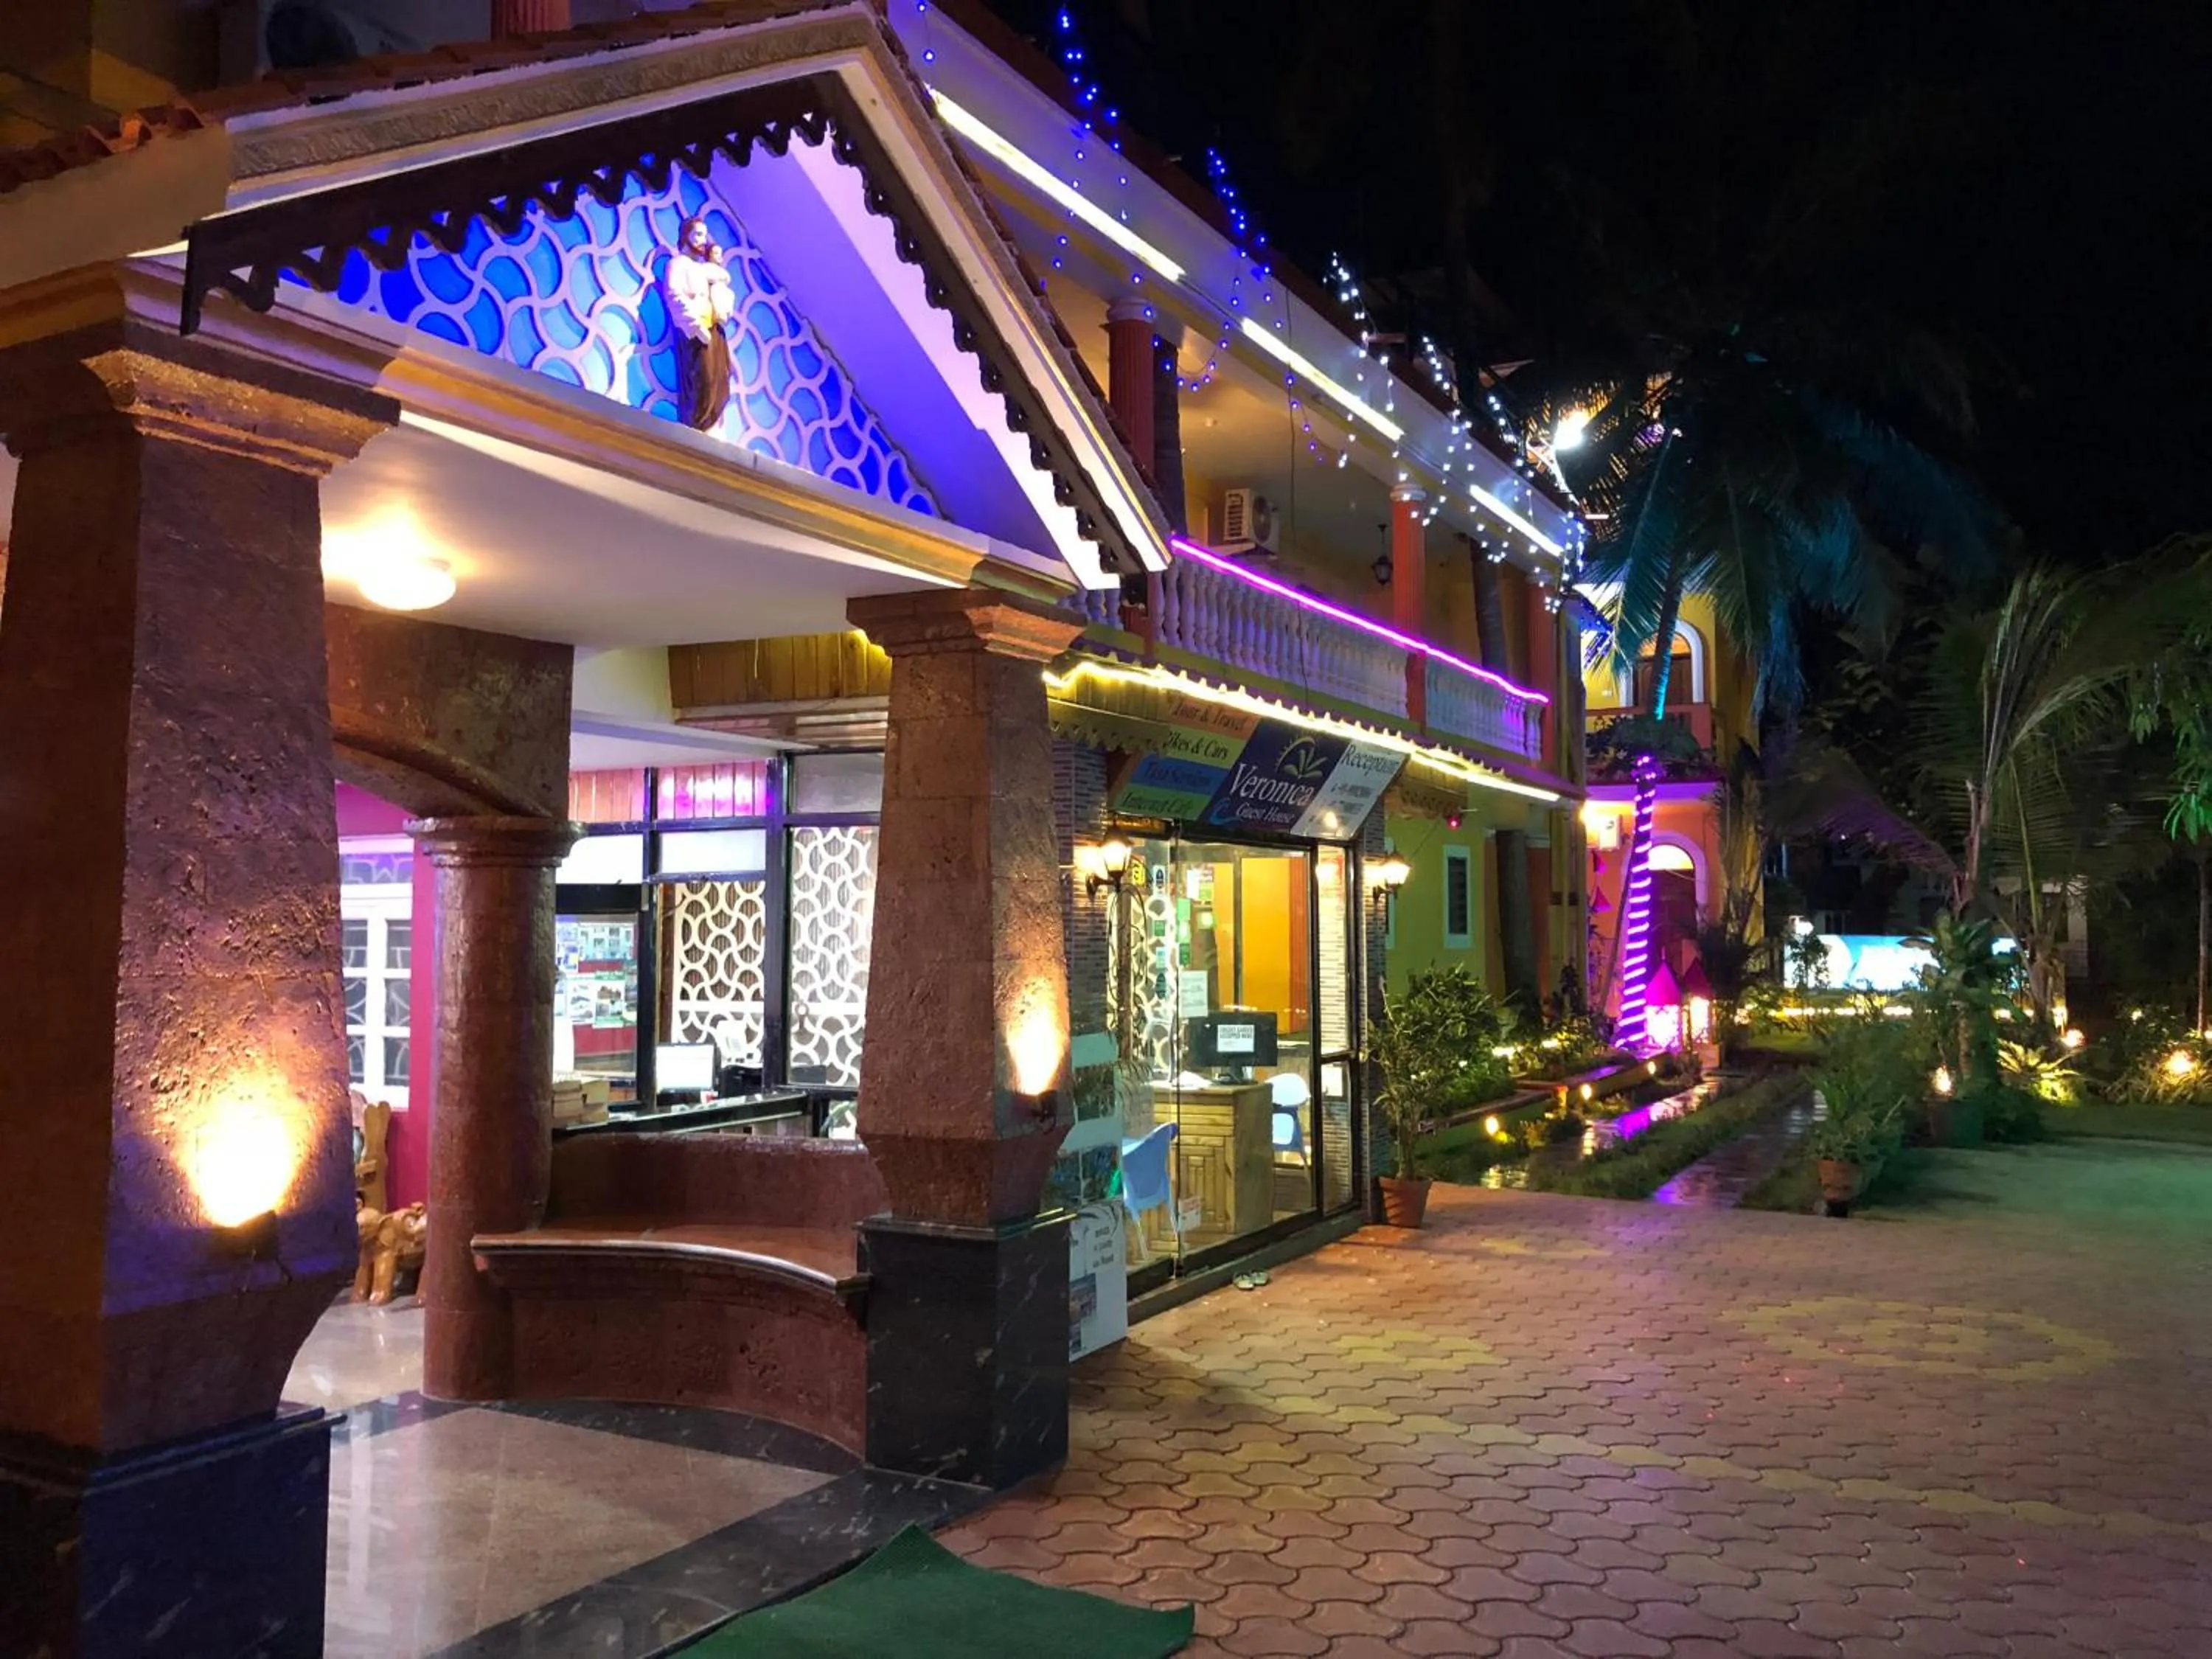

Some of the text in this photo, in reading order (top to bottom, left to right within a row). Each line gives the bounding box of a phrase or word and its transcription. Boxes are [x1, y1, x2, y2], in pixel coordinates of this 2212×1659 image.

[1191, 736, 1204, 754] &
[1205, 740, 1229, 760] Cars
[1340, 743, 1399, 776] Reception
[1229, 762, 1315, 806] Veronica
[1237, 802, 1295, 823] Guest House
